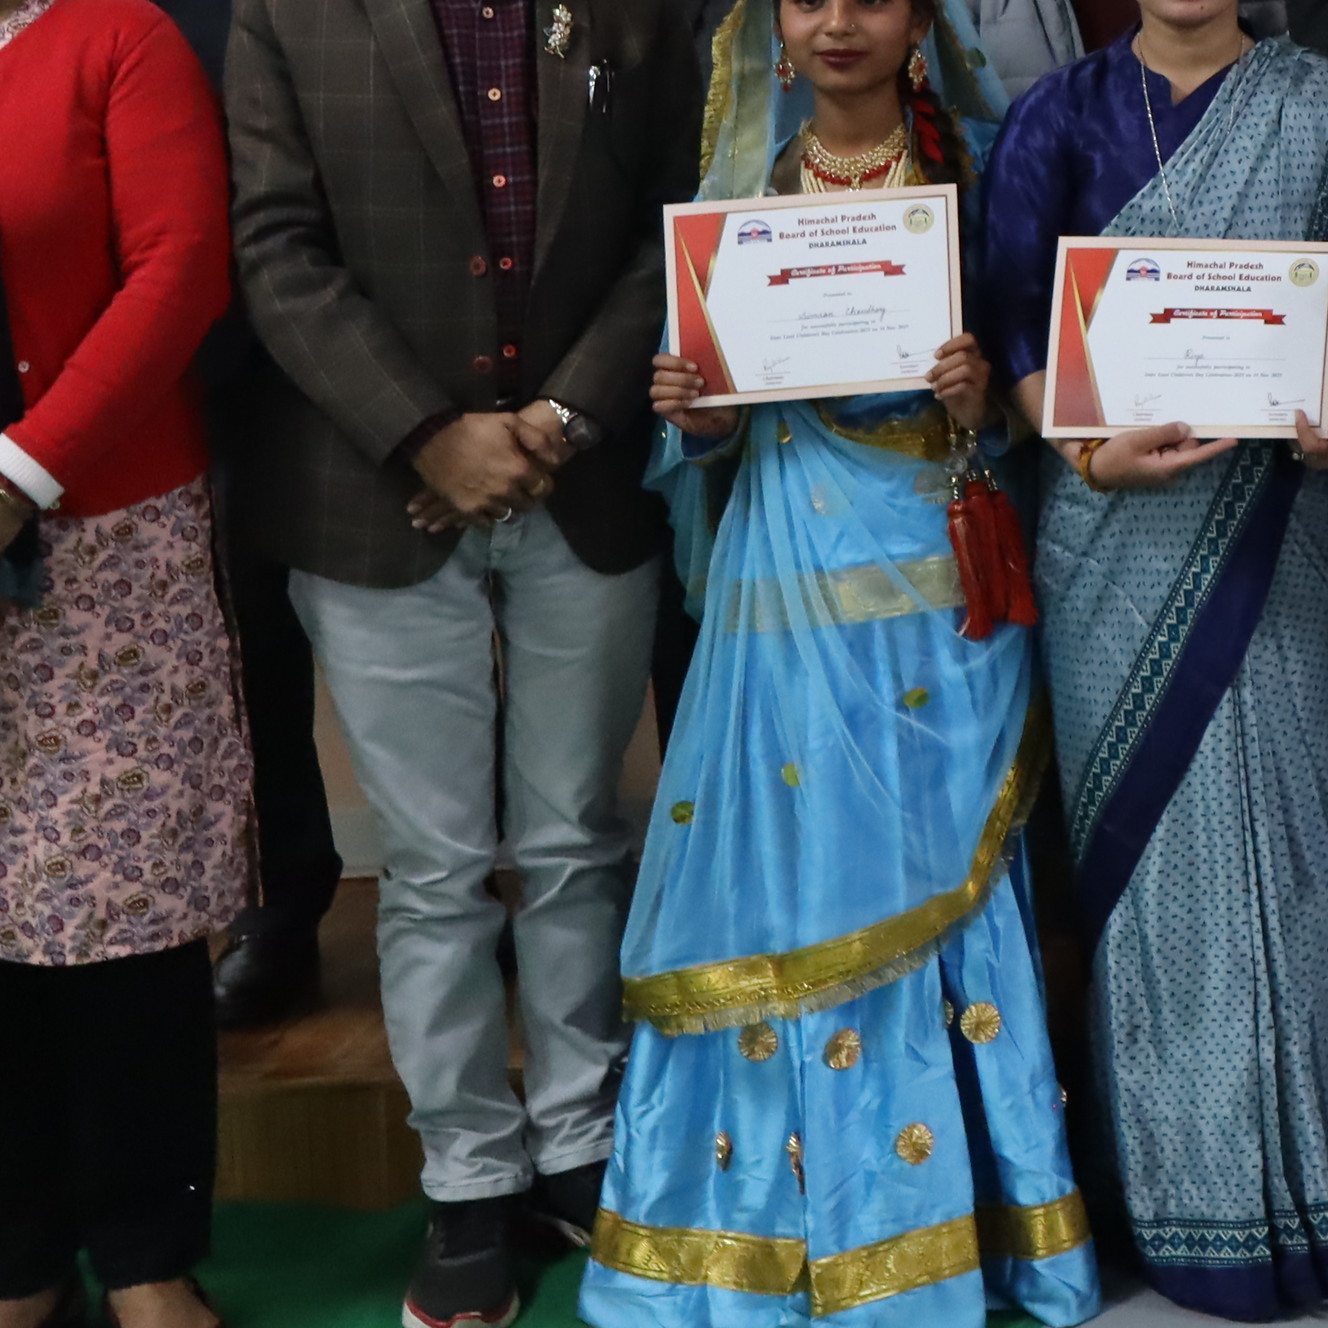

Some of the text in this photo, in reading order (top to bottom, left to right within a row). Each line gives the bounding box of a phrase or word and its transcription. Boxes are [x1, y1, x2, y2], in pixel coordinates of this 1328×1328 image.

[797, 213, 876, 225] Himachal Pradesh
[778, 230, 805, 238] Board
[820, 227, 849, 235] School
[852, 223, 896, 233] Education
[1186, 260, 1264, 269] Himachal Pradesh
[1166, 272, 1282, 282] Board of School Education
